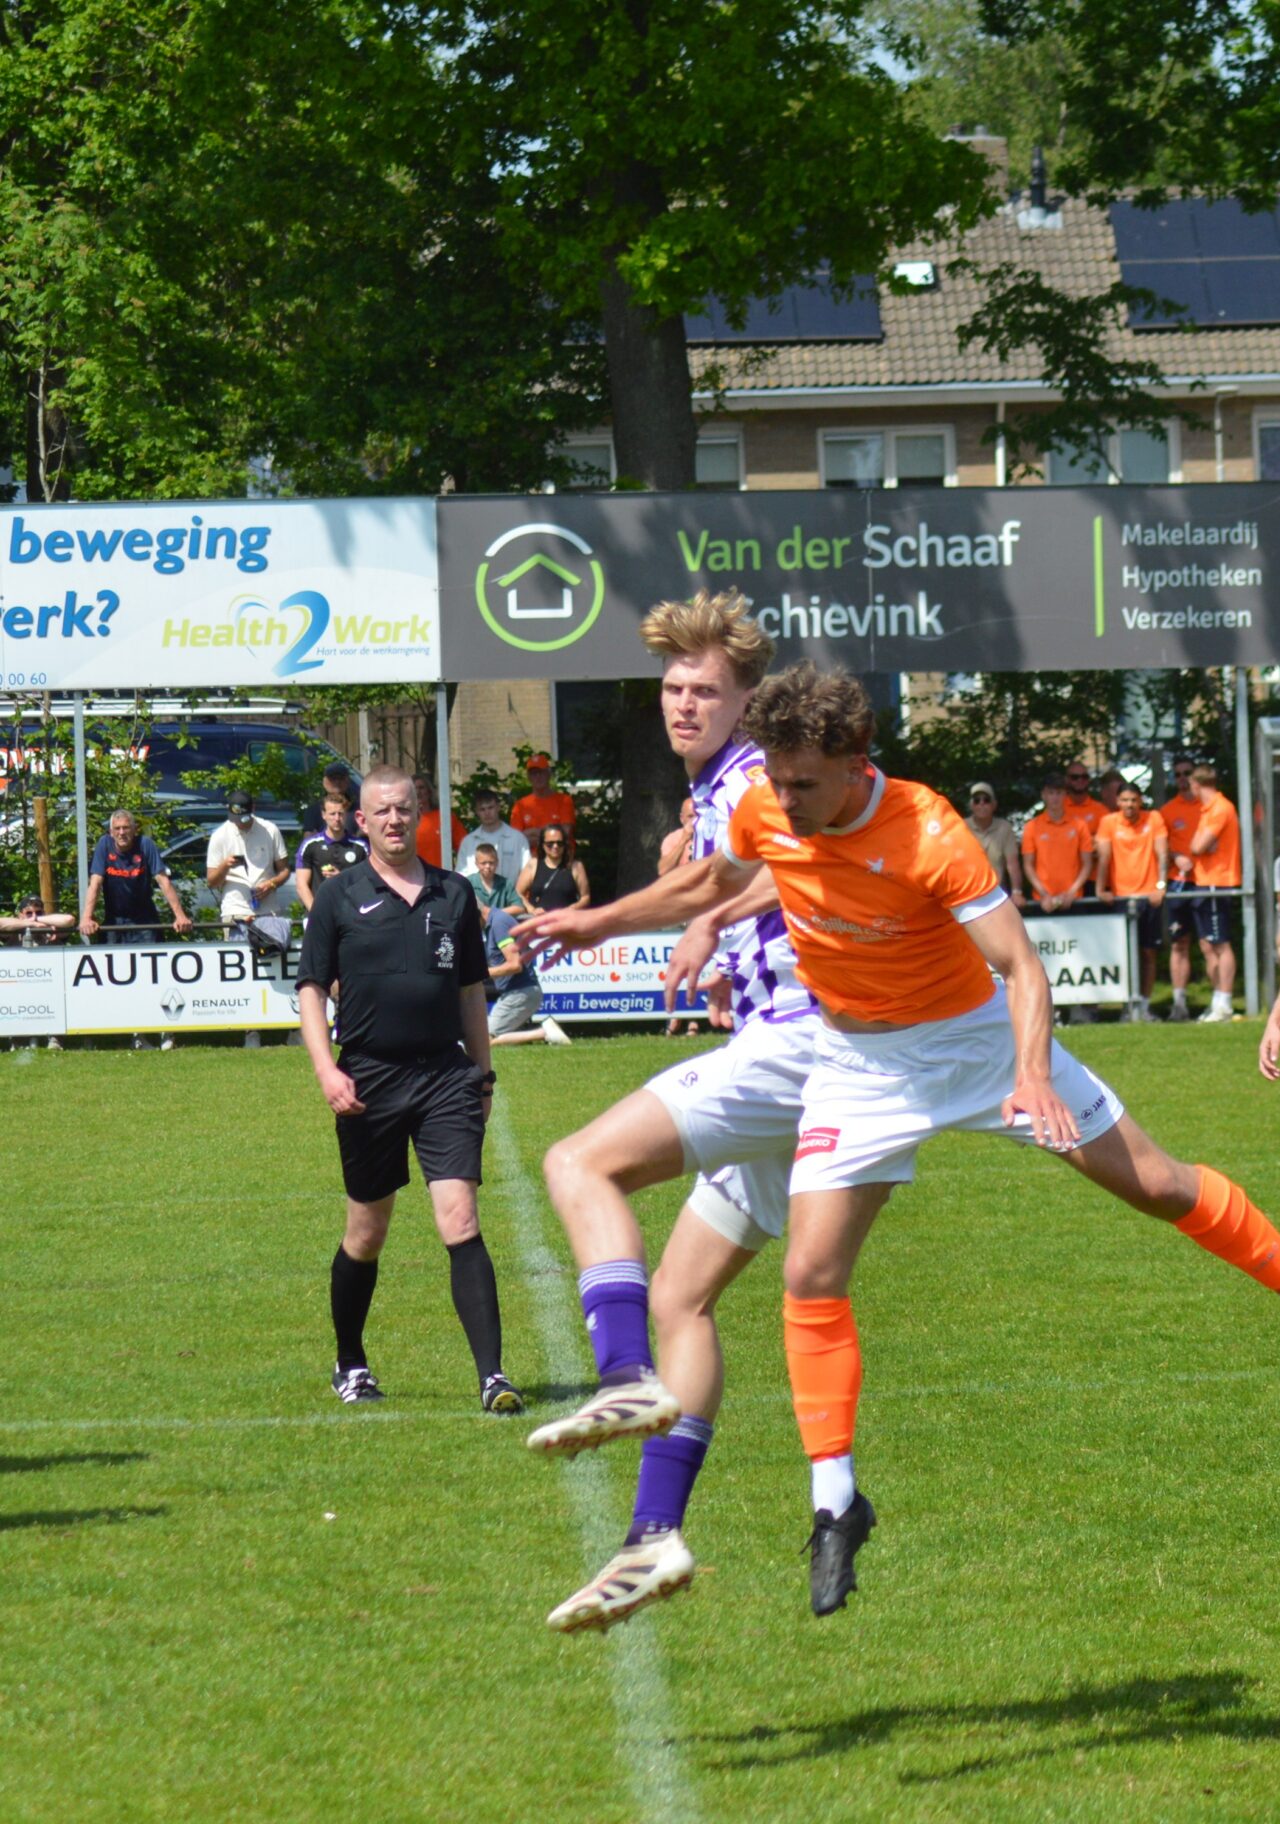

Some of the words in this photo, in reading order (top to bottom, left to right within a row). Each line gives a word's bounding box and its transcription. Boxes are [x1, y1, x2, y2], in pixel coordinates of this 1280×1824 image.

[8, 515, 271, 575] beweging
[677, 530, 760, 572] Van
[776, 525, 851, 570] der
[863, 520, 1021, 569] Schaaf
[1122, 520, 1259, 549] Makelaardij
[1122, 565, 1262, 593] Hypotheken
[0, 589, 120, 639] erk?
[1122, 606, 1253, 630] Verzekeren
[339, 648, 358, 656] voor
[360, 647, 370, 655] de
[8, 672, 26, 686] 00
[30, 672, 47, 685] 60
[578, 946, 629, 967] OLIE
[72, 951, 204, 987] AUTO
[625, 971, 654, 982] SHOP
[1049, 965, 1120, 987] AAN
[192, 998, 251, 1008] RENAULT
[562, 996, 574, 1010] in
[579, 993, 655, 1013] beweging
